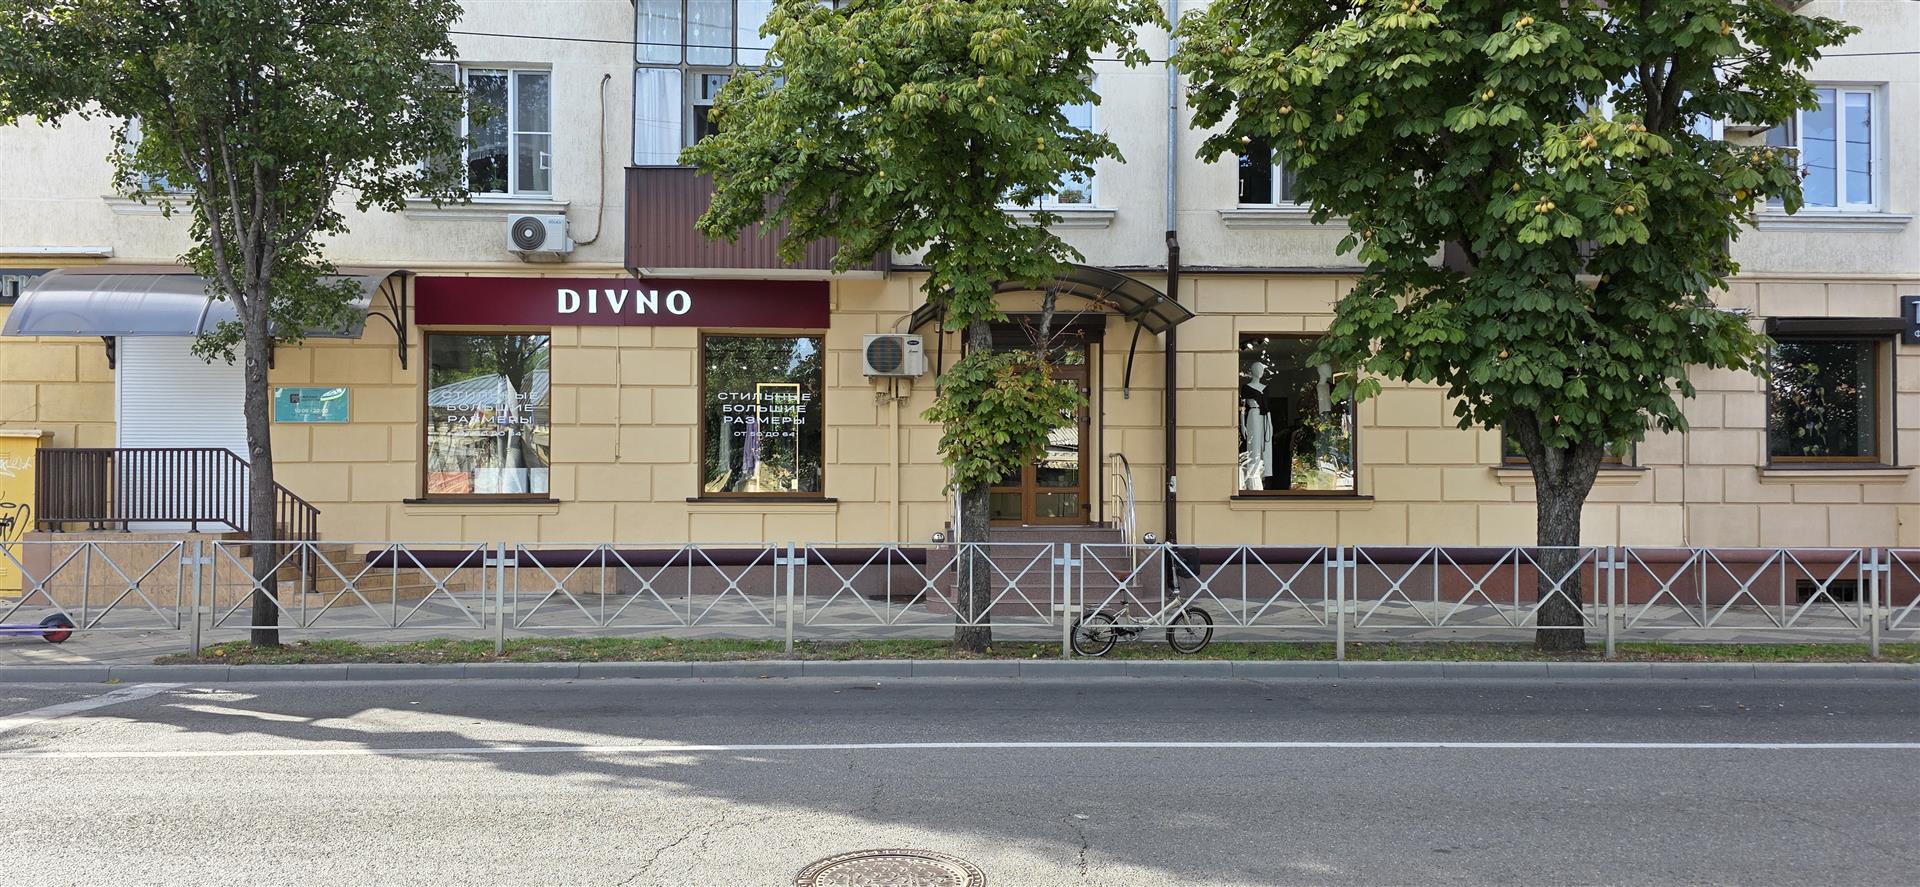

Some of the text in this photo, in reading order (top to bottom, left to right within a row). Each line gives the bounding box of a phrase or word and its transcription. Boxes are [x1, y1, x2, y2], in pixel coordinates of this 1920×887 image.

[557, 289, 692, 315] DIVNO
[717, 392, 811, 401] СТИЛЬНЫЕ
[722, 404, 806, 413] БОЛЬШИЕ
[723, 415, 805, 425] РАЗМЕРЫ
